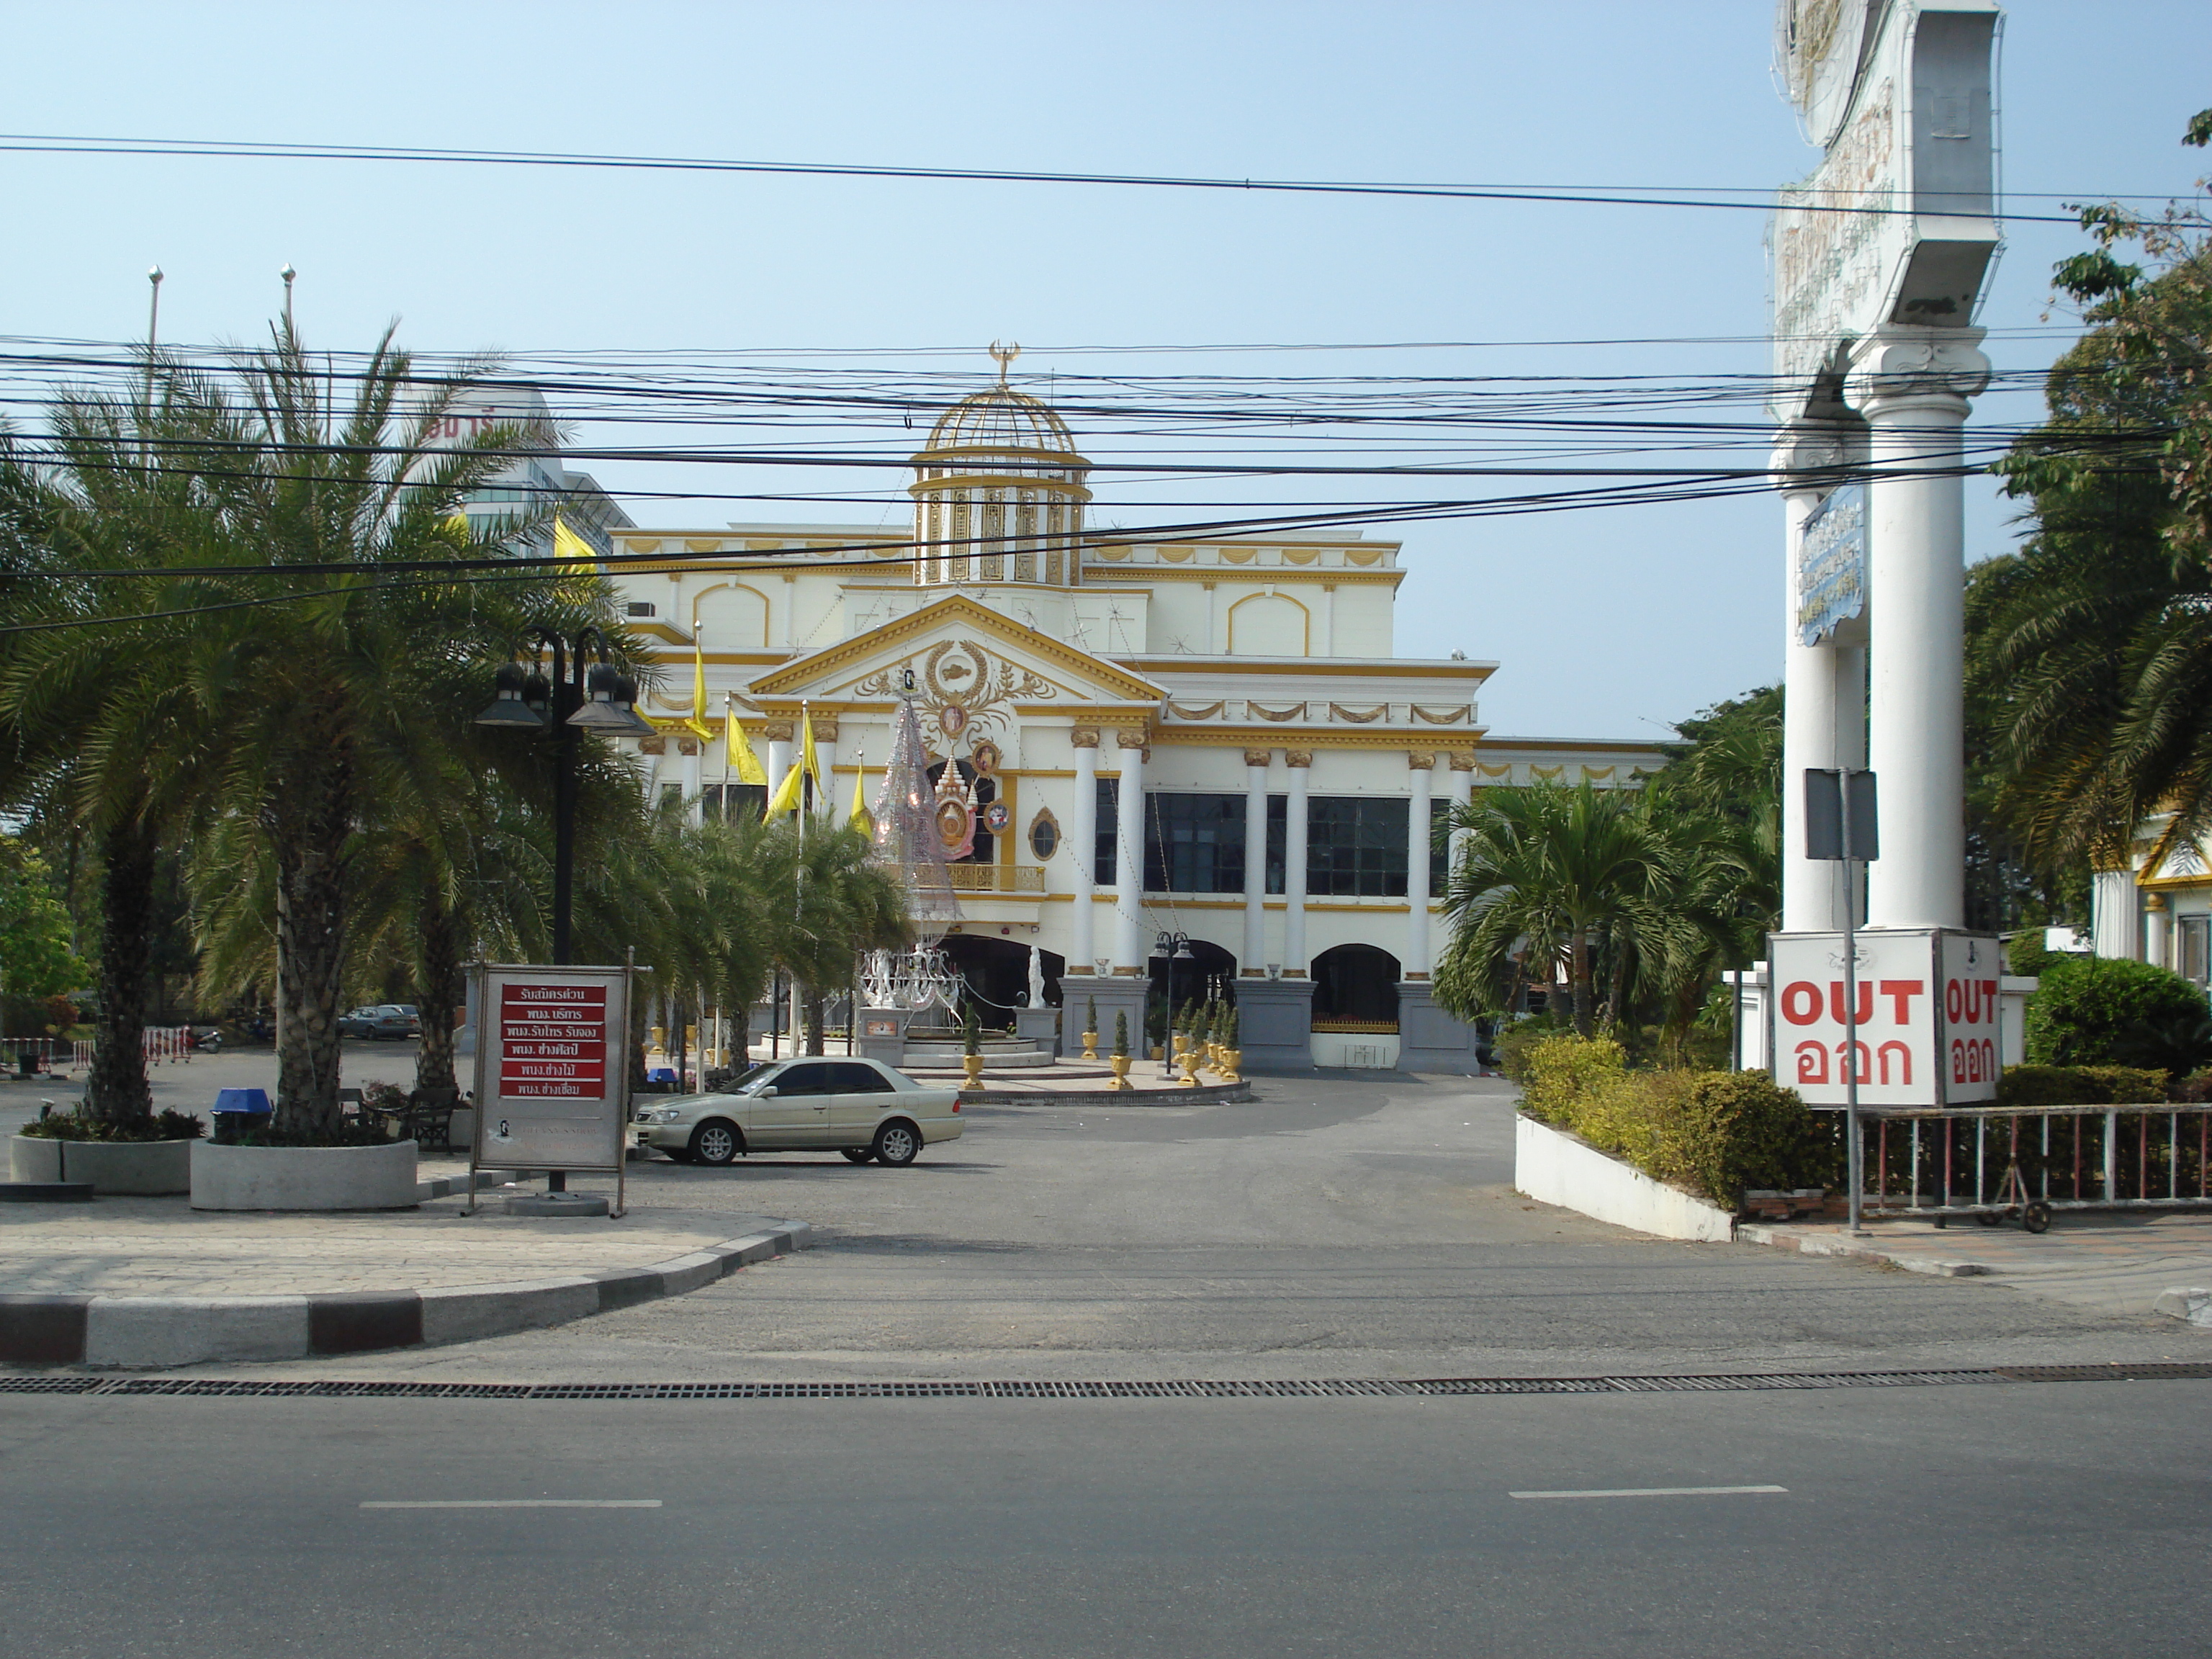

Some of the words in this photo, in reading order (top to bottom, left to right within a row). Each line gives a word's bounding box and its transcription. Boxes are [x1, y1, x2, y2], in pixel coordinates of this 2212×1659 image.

[521, 987, 585, 1000] รับสมัครด่วน
[552, 1008, 583, 1020] บริการ
[1781, 979, 1924, 1026] OUT
[1946, 978, 1997, 1025] OUT
[565, 1025, 597, 1038] รับจอง
[1794, 1039, 1912, 1086] ออก
[1951, 1038, 1995, 1084] ออก
